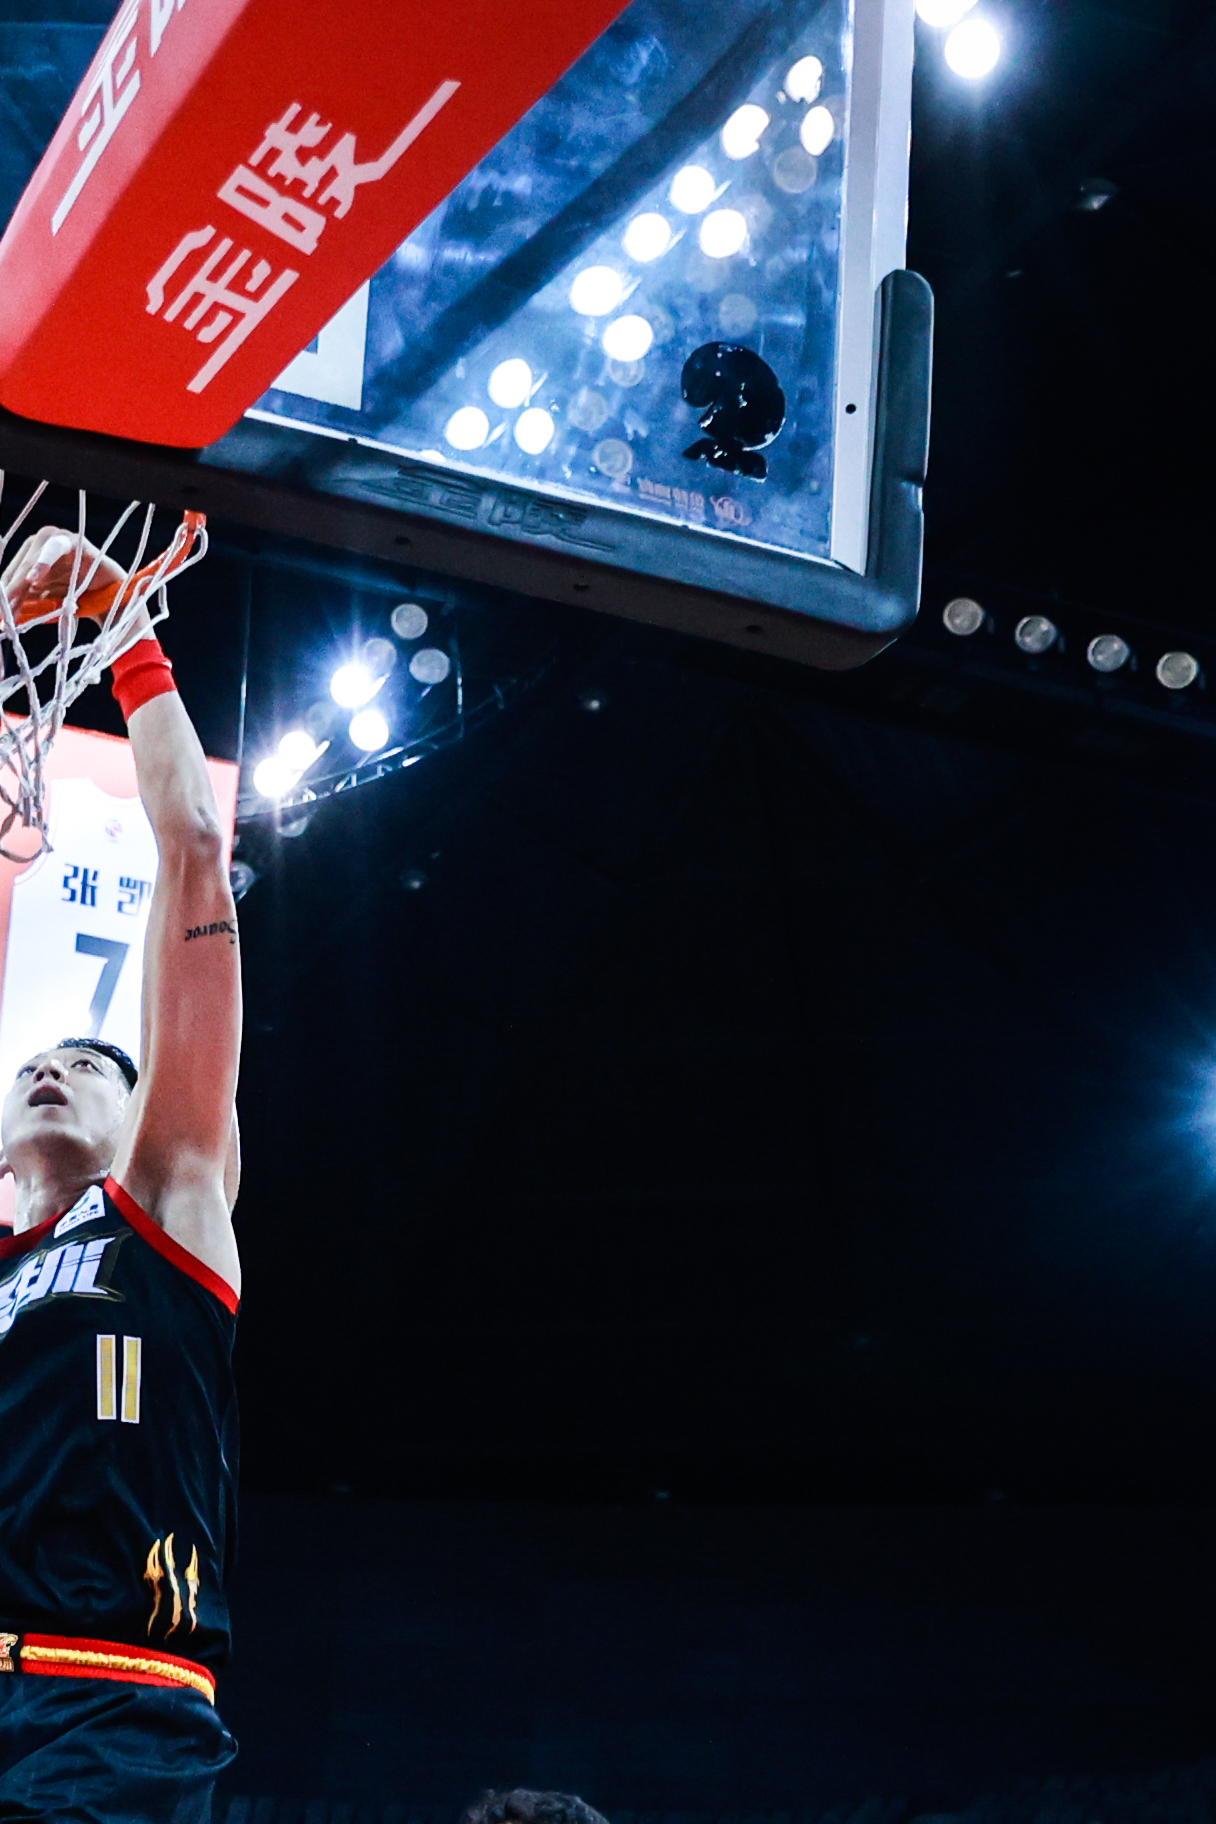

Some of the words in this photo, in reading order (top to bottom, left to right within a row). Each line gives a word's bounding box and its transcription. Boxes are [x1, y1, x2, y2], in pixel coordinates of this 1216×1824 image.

[145, 79, 462, 394] 金陵
[75, 932, 130, 1042] 7
[97, 1334, 142, 1424] 11
